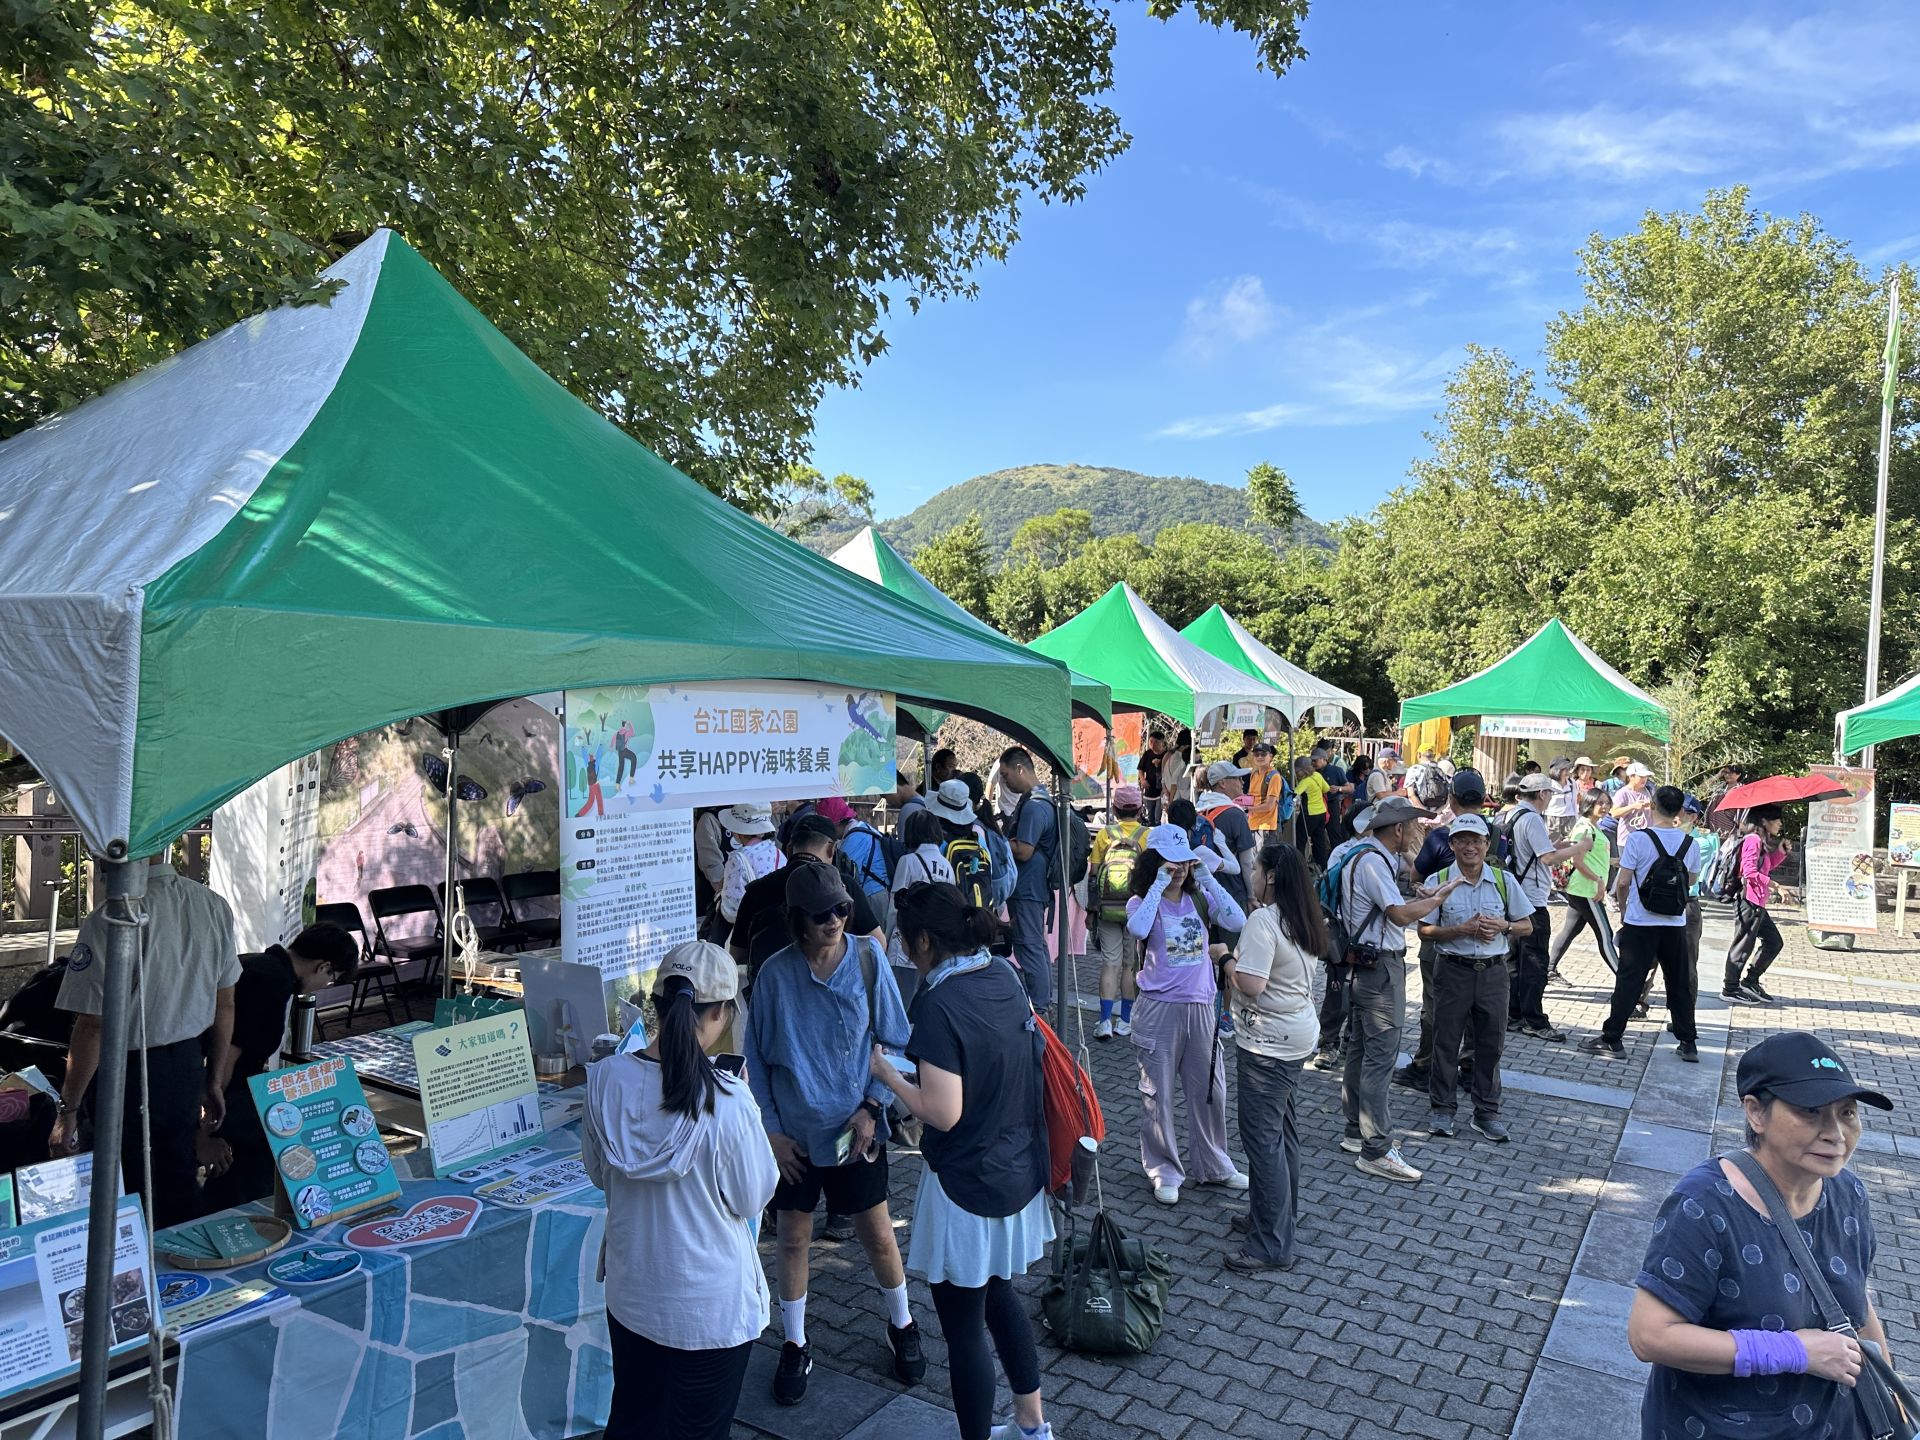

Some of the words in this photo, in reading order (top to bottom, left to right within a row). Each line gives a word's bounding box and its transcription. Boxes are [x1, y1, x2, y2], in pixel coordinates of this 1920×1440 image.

[693, 708, 799, 735] 台江國家公園
[658, 746, 831, 780] 共享HAPPY海味餐桌
[671, 963, 692, 971] POLO
[268, 1058, 345, 1092] 生態友善棲地
[285, 1073, 336, 1101] 營造原則
[377, 1206, 449, 1236] 安心水產
[0, 1236, 20, 1250] 地的
